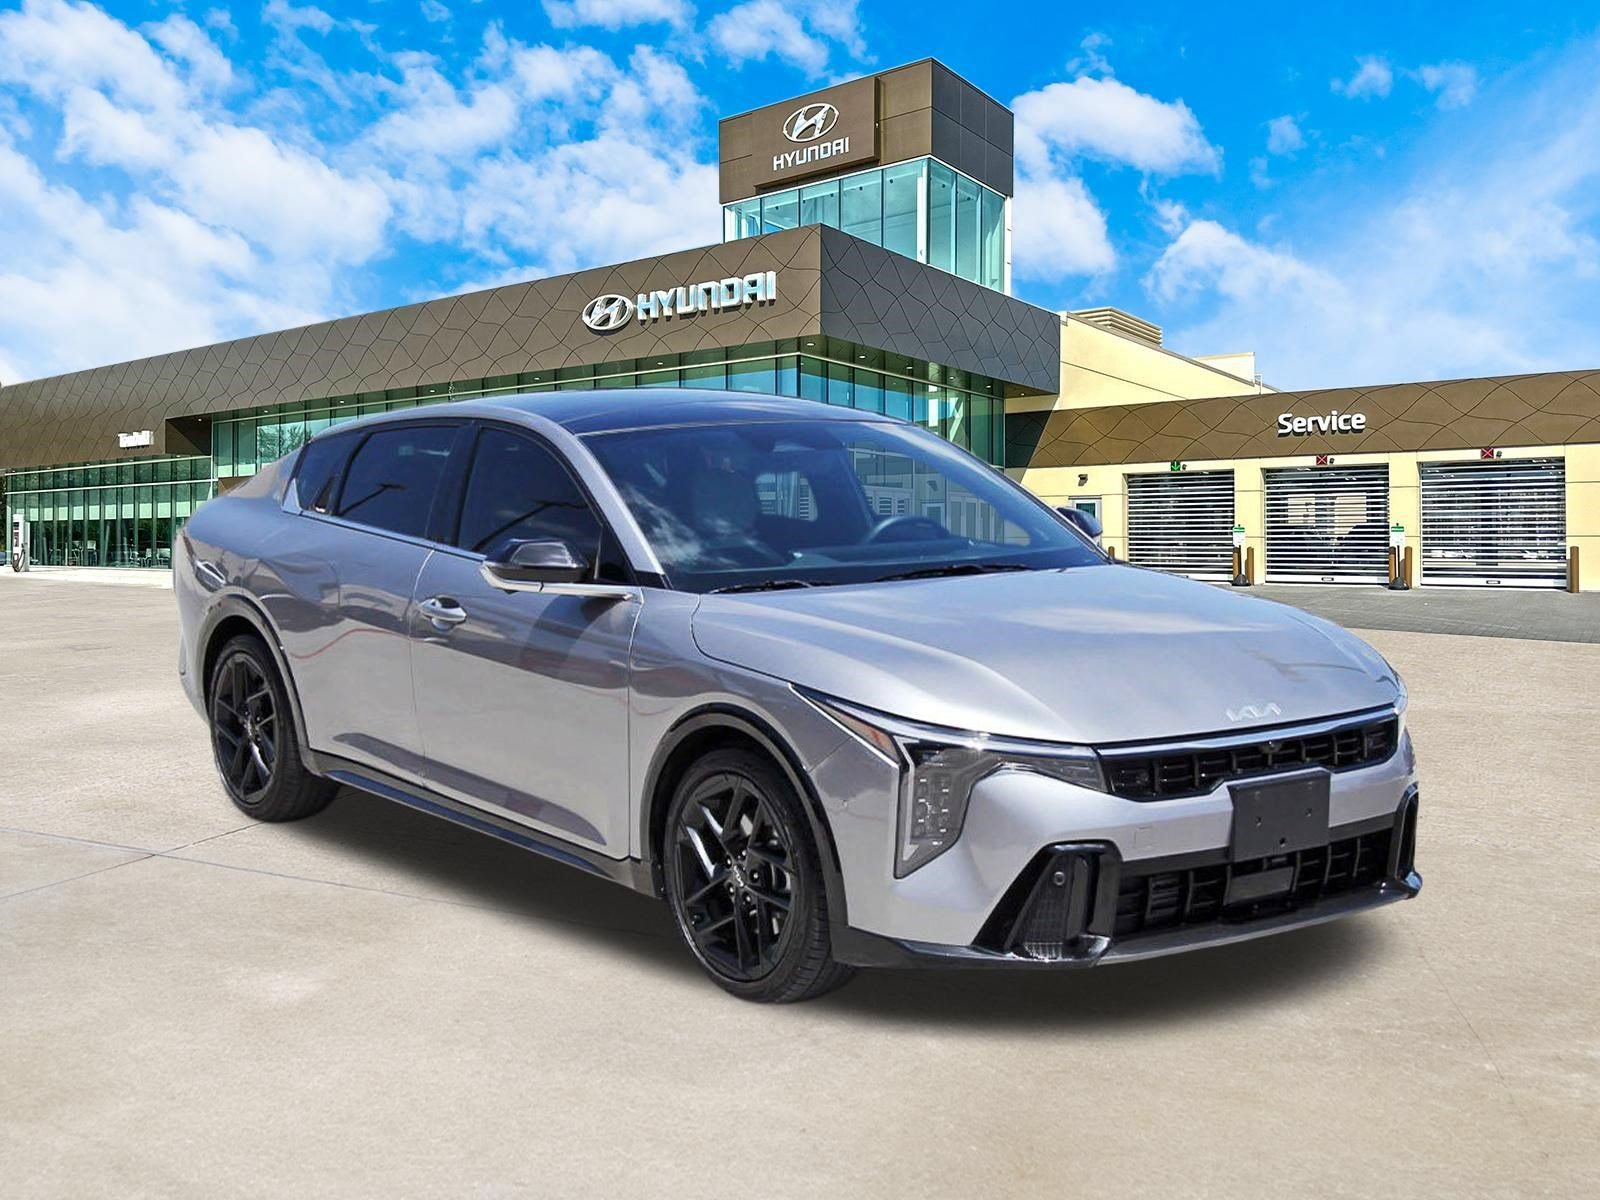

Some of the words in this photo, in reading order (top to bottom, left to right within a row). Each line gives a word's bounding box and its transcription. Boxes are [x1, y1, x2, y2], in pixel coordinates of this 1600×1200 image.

[773, 137, 849, 171] HYUNDAI
[637, 270, 776, 321] HYUNDAI
[1278, 410, 1366, 434] Service
